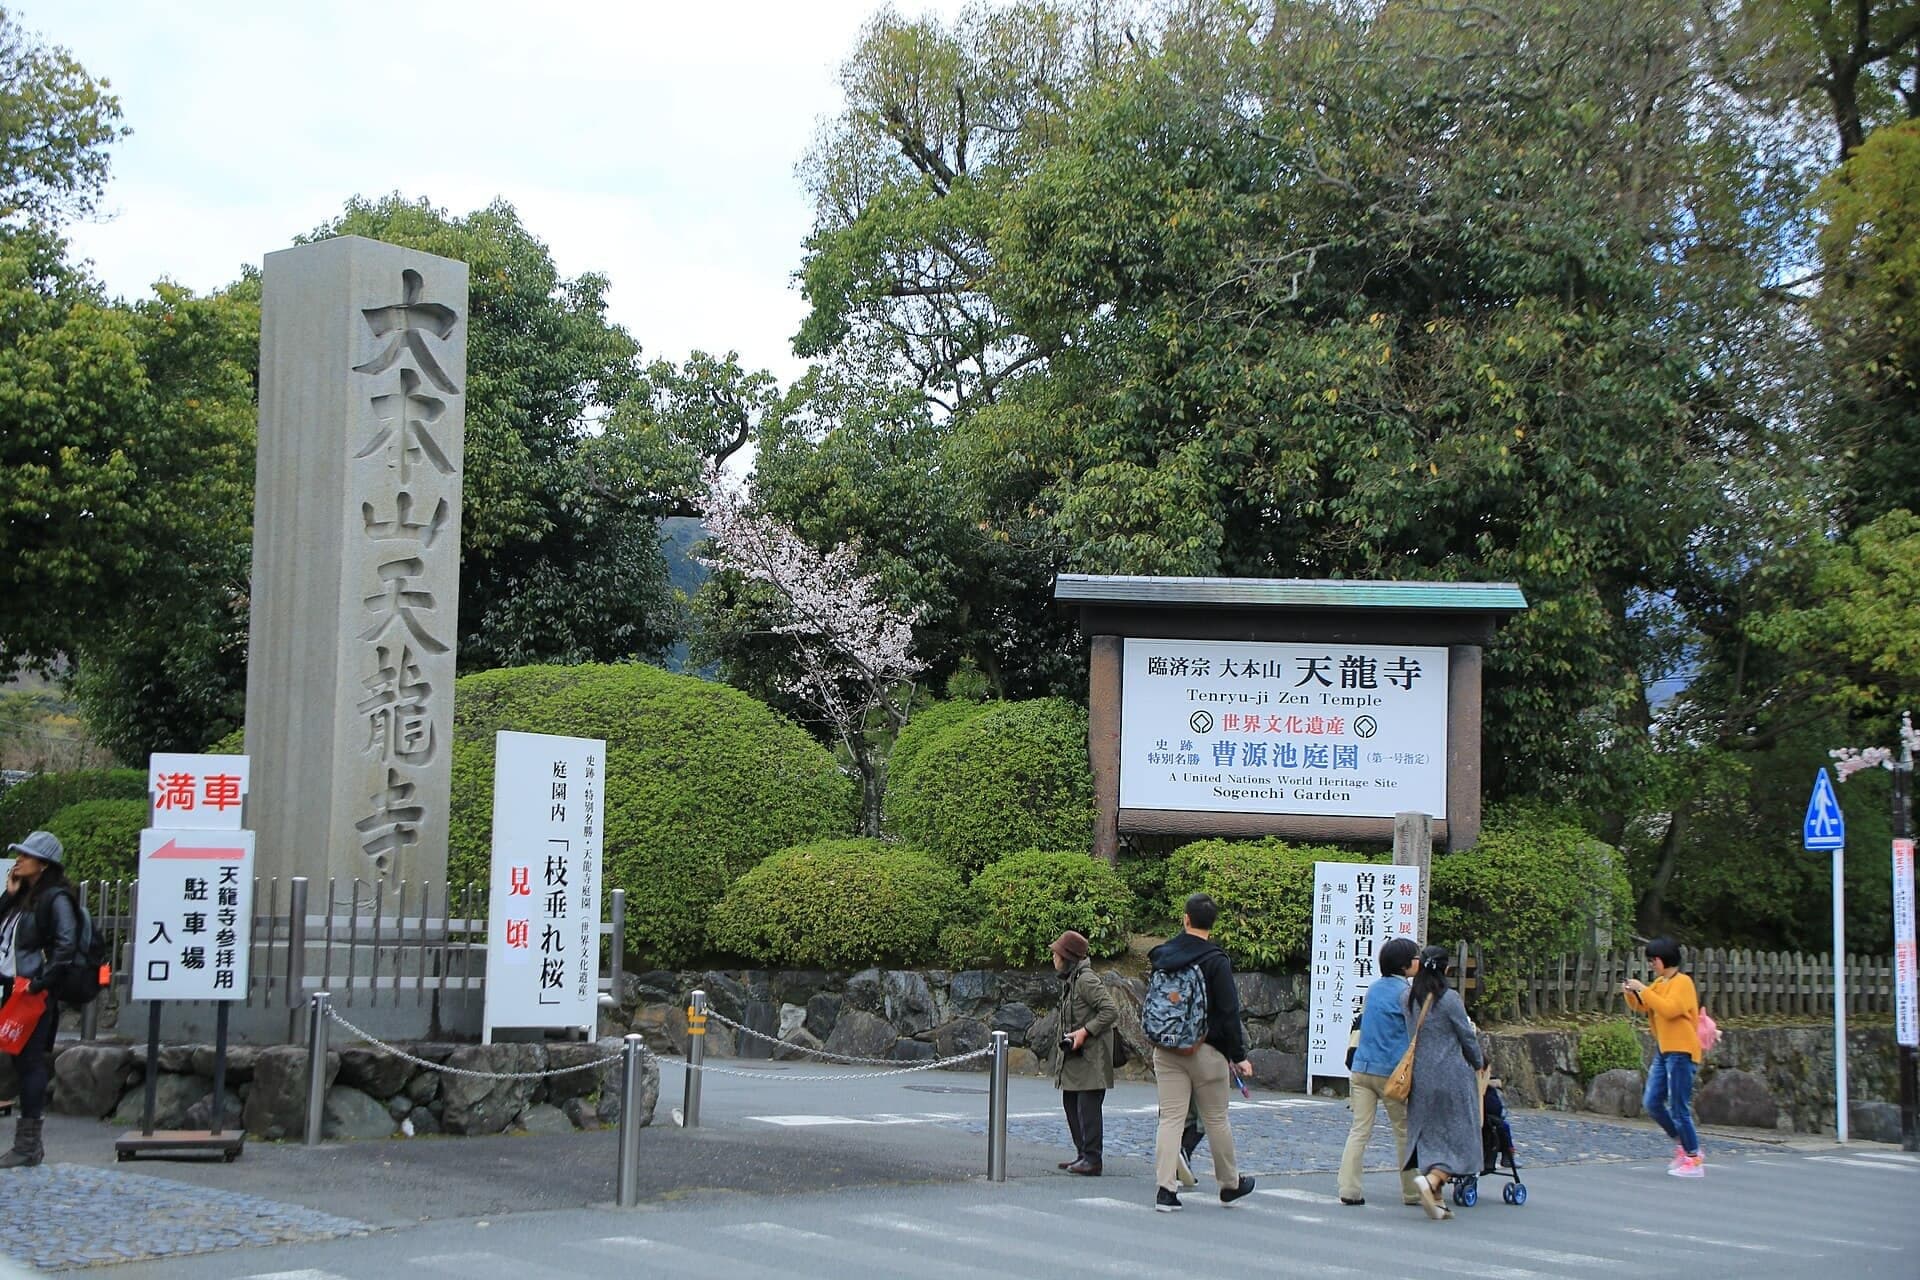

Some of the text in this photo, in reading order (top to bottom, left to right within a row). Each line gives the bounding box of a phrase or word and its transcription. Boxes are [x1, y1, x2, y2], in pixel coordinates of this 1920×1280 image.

[352, 269, 459, 894] 大本山天龍寺
[1148, 654, 1422, 691] 臨済宗 大本山 天龍寺
[1186, 688, 1382, 708] Tenryu-ji Zen Temple
[1222, 713, 1345, 735] 世界文化遺産
[1147, 752, 1200, 766] 特別名勝
[1211, 740, 1359, 770] 曹源池庭園
[155, 772, 242, 812] 満車
[1168, 772, 1398, 789] A United Nations World Heritage Site
[1213, 786, 1351, 801] Sogenchi Garden
[180, 877, 208, 970] 駐車場
[506, 866, 532, 949] 見頃
[1399, 883, 1413, 935] 特別展
[213, 866, 240, 989] 天龍寺参拝用
[147, 920, 173, 982] 入口
